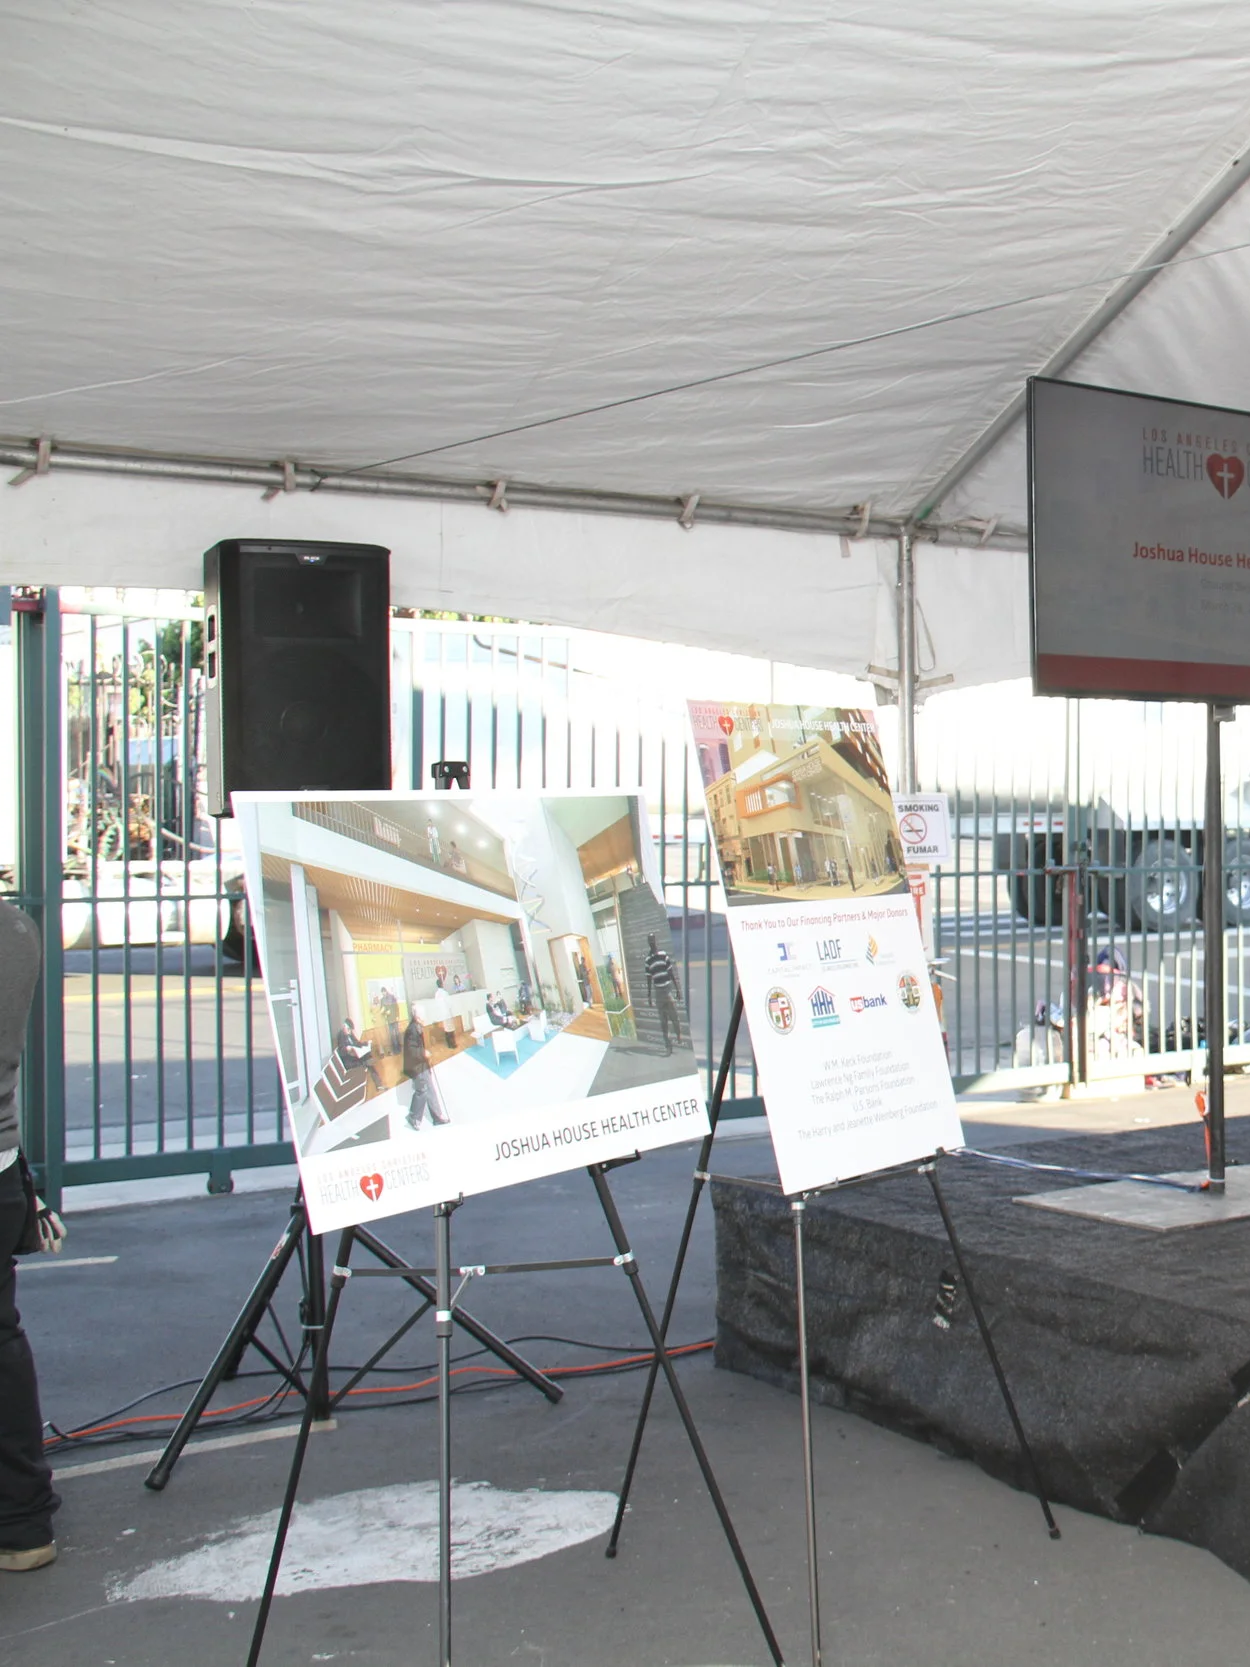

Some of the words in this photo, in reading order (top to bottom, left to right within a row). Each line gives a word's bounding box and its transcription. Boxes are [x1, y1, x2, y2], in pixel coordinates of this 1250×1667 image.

[1142, 427, 1167, 443] LOS
[1176, 433, 1237, 455] ANGELES
[1143, 446, 1204, 482] HEALTH
[1132, 541, 1184, 563] Joshua
[1188, 547, 1233, 568] House
[800, 719, 824, 732] HOUSE
[850, 721, 876, 734] CENTER
[897, 803, 940, 814] SMOKING
[906, 845, 939, 855] FUMAR
[741, 919, 763, 933] Thank
[764, 917, 777, 931] You
[787, 914, 799, 928] Our
[800, 911, 833, 927] Financing
[833, 909, 861, 924] Partners
[867, 907, 886, 921] Major
[887, 905, 909, 919] Donors
[352, 941, 394, 954] PHARMACY
[815, 937, 843, 962] LADF
[857, 1050, 893, 1065] Foundation
[810, 1074, 842, 1091] Lawrence
[875, 1061, 910, 1076] Foundation
[880, 1075, 916, 1090] Foundation
[866, 1096, 883, 1109] Bank
[496, 1132, 551, 1162] JOSHUA
[552, 1120, 600, 1149] HOUSE
[600, 1108, 651, 1137] HEALTH
[652, 1097, 701, 1125] CENTER
[797, 1128, 812, 1141] The
[812, 1125, 832, 1139] Harry
[832, 1121, 846, 1133] and
[904, 1100, 939, 1116] Foundation
[320, 1179, 360, 1206] HEALTH
[384, 1162, 431, 1190] CENTERS
